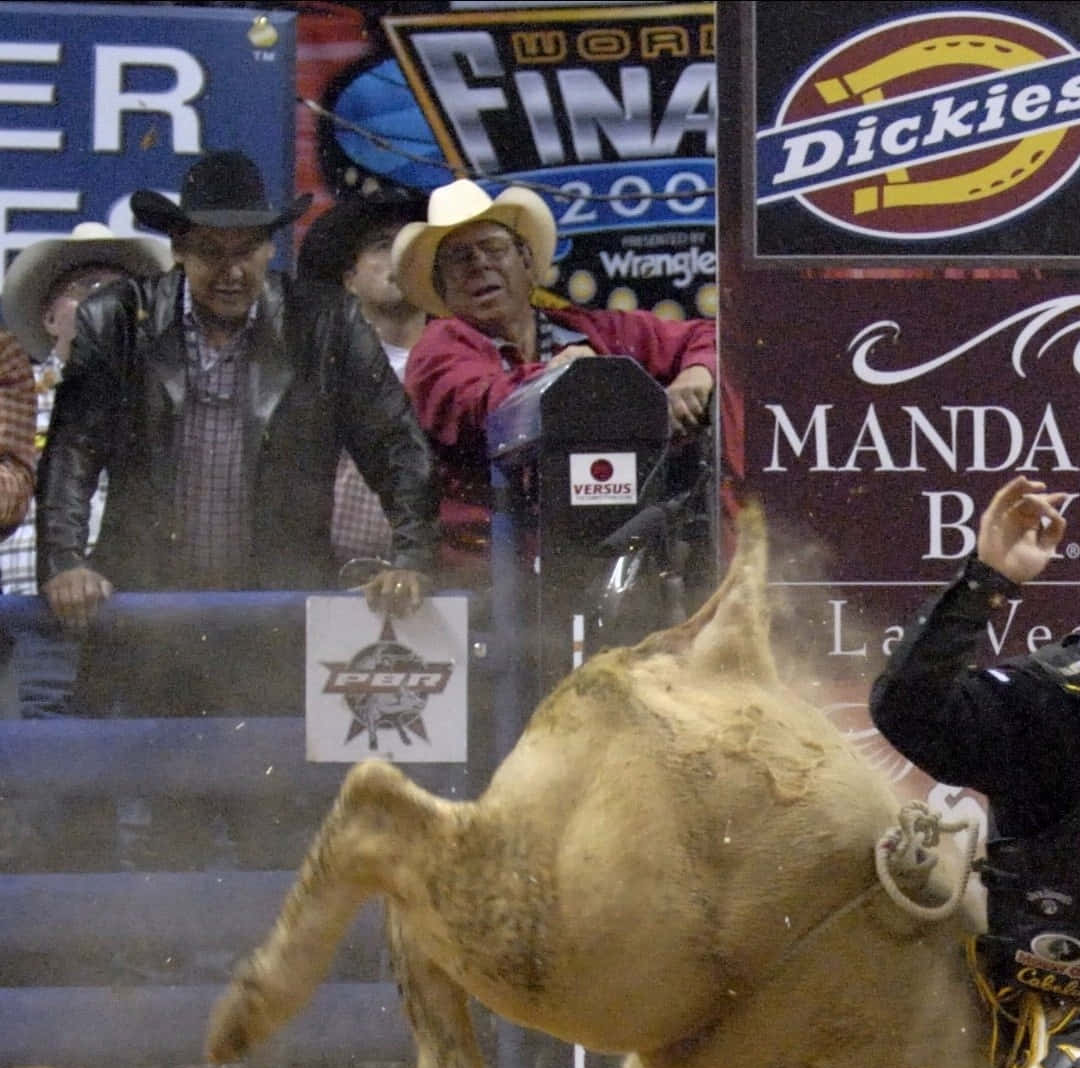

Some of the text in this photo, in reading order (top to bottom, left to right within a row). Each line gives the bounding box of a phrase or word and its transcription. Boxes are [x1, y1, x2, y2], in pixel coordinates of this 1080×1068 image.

[510, 23, 715, 65] WOR
[573, 483, 632, 495] VERSUS
[334, 672, 443, 687] PBR
